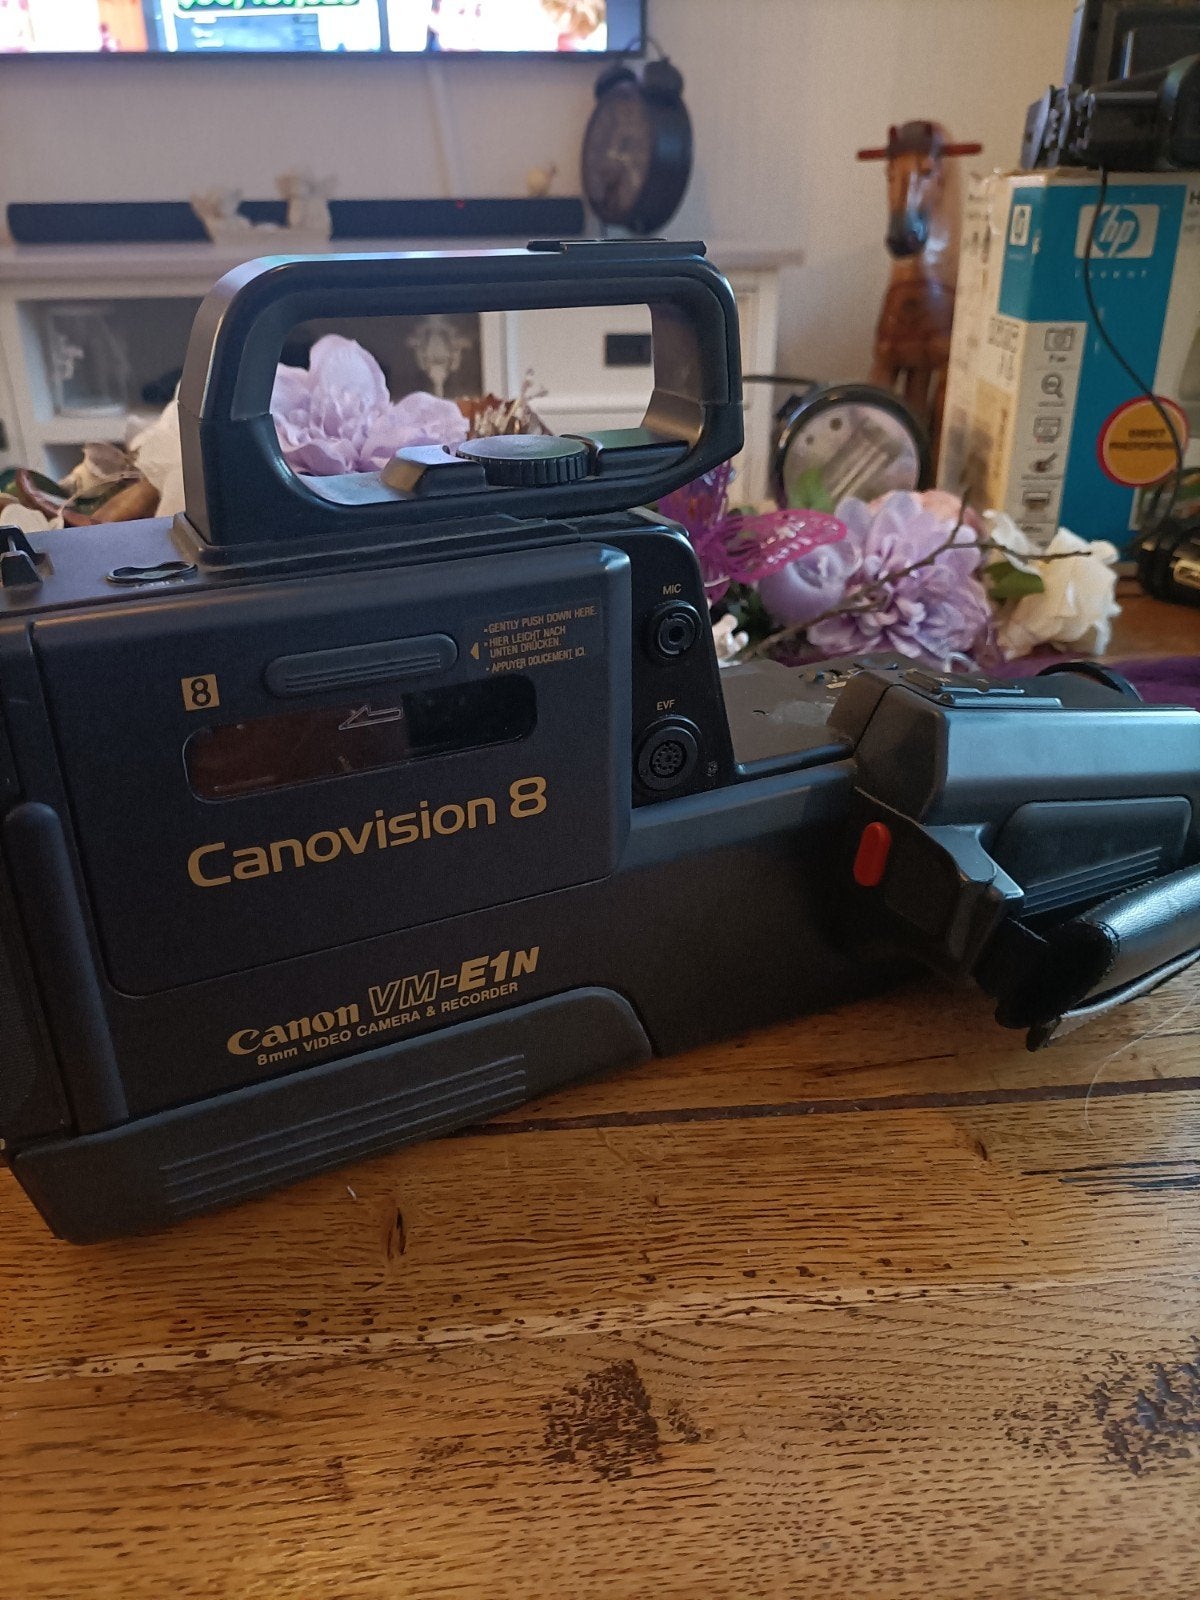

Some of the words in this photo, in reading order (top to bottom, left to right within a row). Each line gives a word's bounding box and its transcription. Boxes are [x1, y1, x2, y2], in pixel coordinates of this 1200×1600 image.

[1093, 205, 1140, 258] hp
[662, 583, 682, 595] MIC
[521, 614, 544, 628] PUSH
[547, 610, 572, 622] DOWN
[489, 635, 509, 648] HIER
[511, 629, 541, 644] LEICHT
[543, 625, 566, 638] NACH
[490, 644, 519, 659] UNTEN
[491, 657, 527, 674] APPUYER
[528, 648, 574, 666] DOUCEMENT
[188, 676, 213, 709] 8
[656, 699, 676, 711] EVF
[187, 796, 497, 888] Canovision
[508, 776, 548, 819] 8
[227, 1003, 361, 1056] Canon
[368, 946, 540, 1017] VM-E1N
[257, 1046, 298, 1066] 8mm
[303, 1030, 352, 1053] VIDEO
[357, 1010, 421, 1038] CAMERA
[426, 1005, 436, 1017] &
[441, 982, 519, 1014] RECORDER
